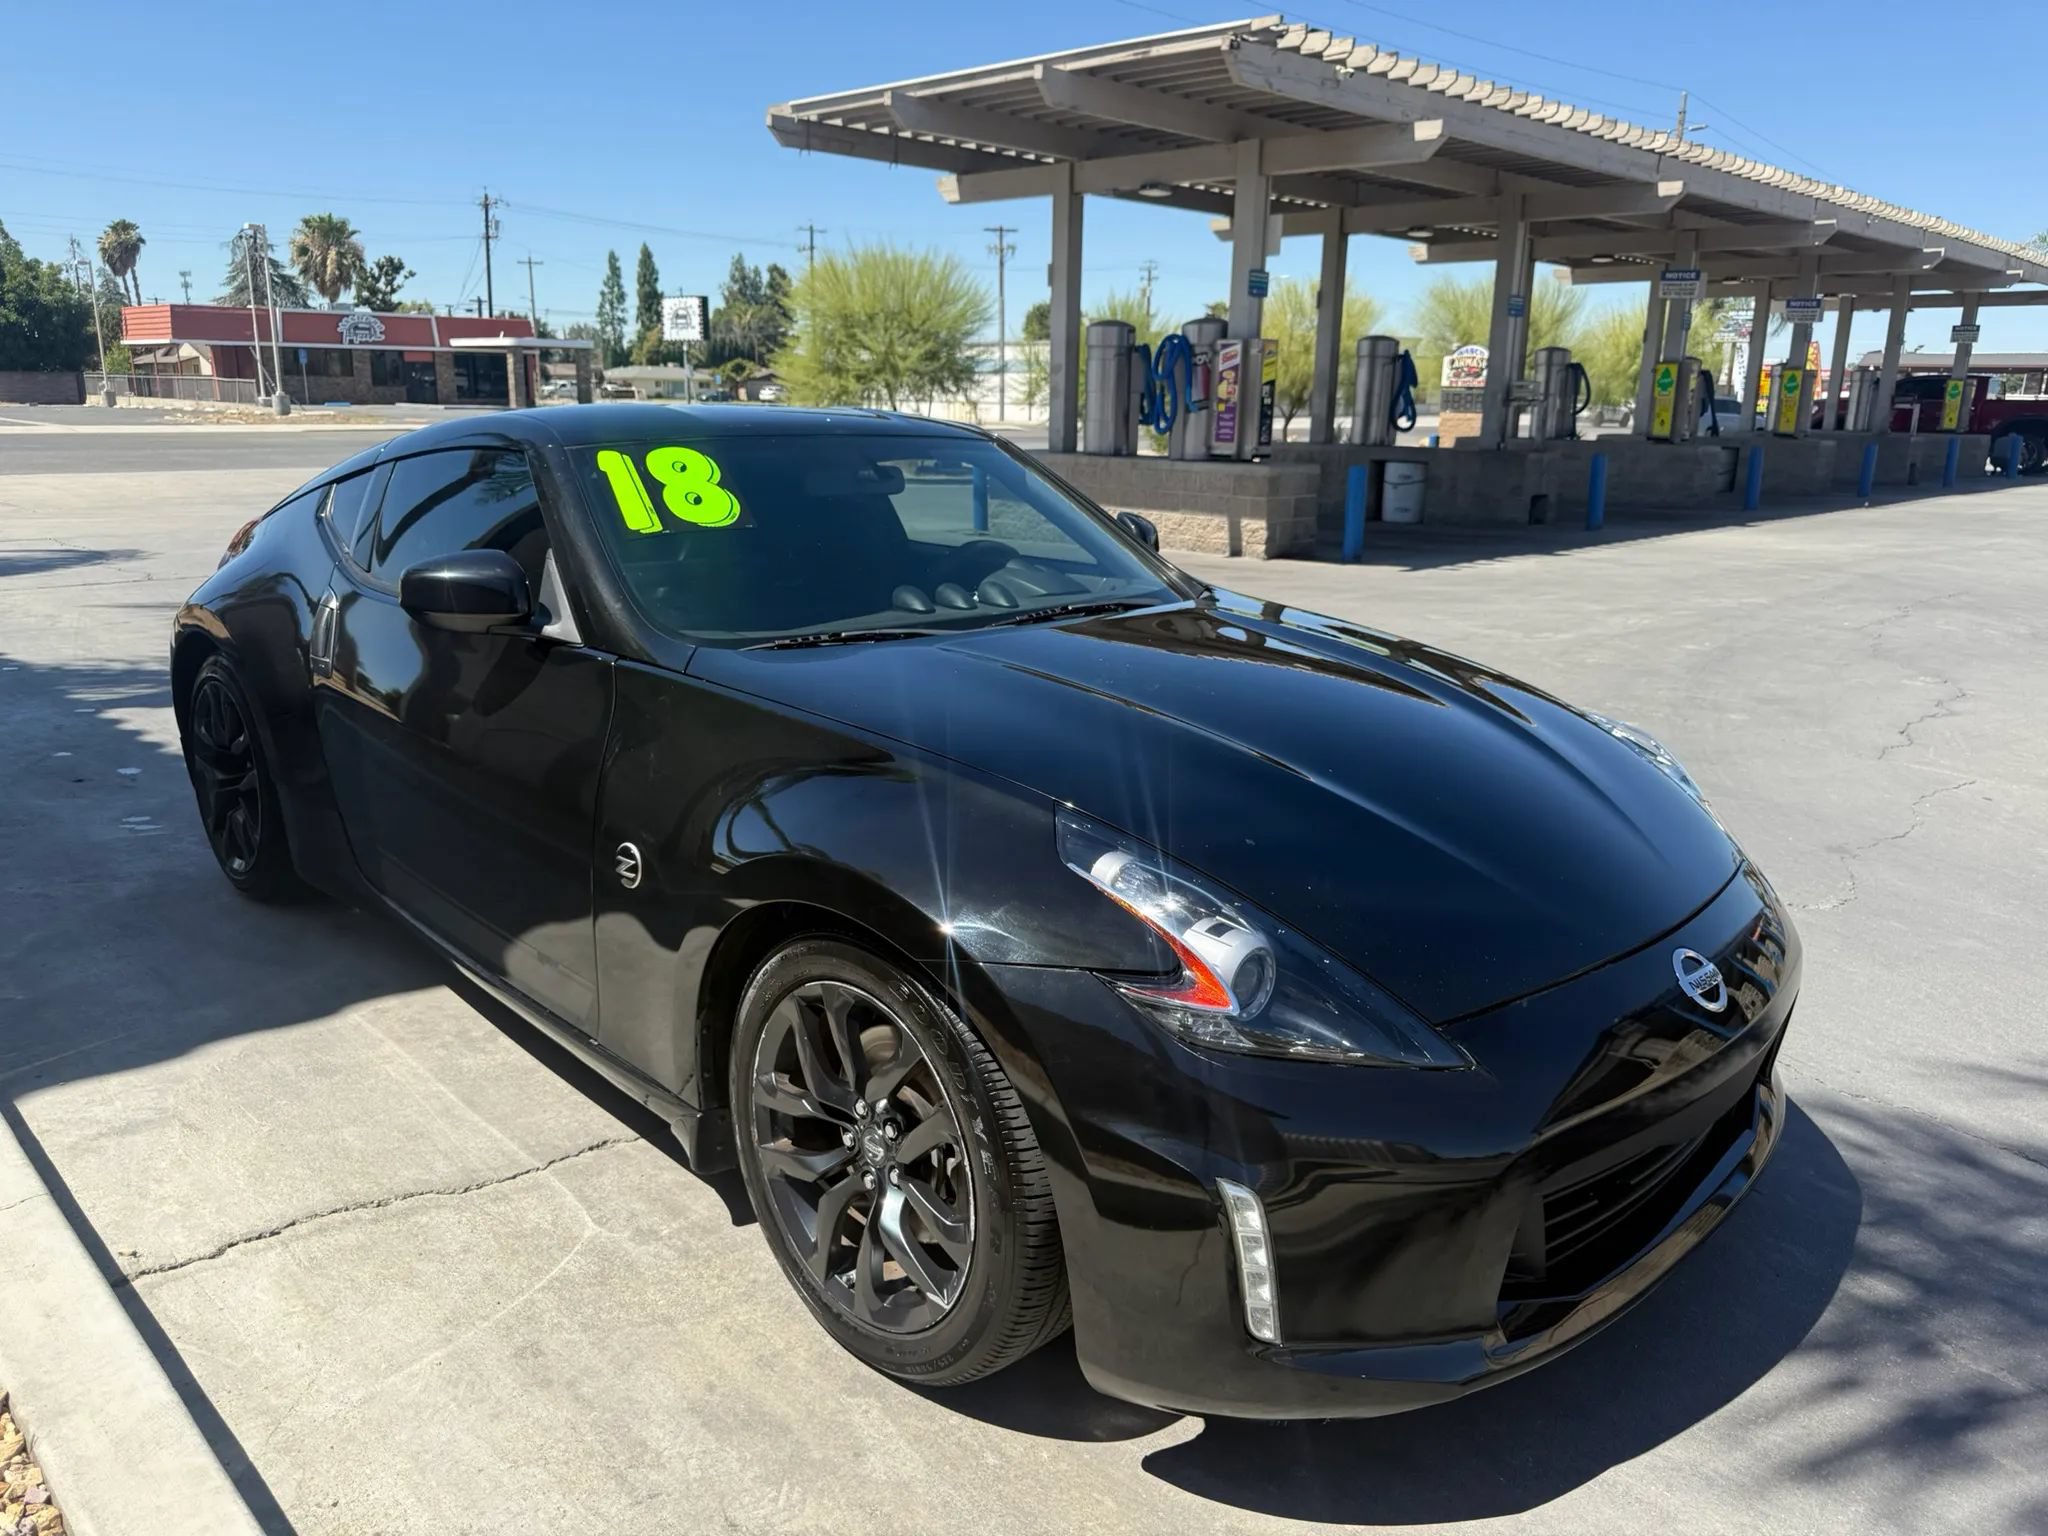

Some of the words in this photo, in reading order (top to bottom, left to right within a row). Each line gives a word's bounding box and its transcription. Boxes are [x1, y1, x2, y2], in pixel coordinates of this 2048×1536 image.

[1665, 271, 1697, 279] NOTICE
[597, 446, 742, 534] 18
[1688, 967, 1720, 991] NISSAN
